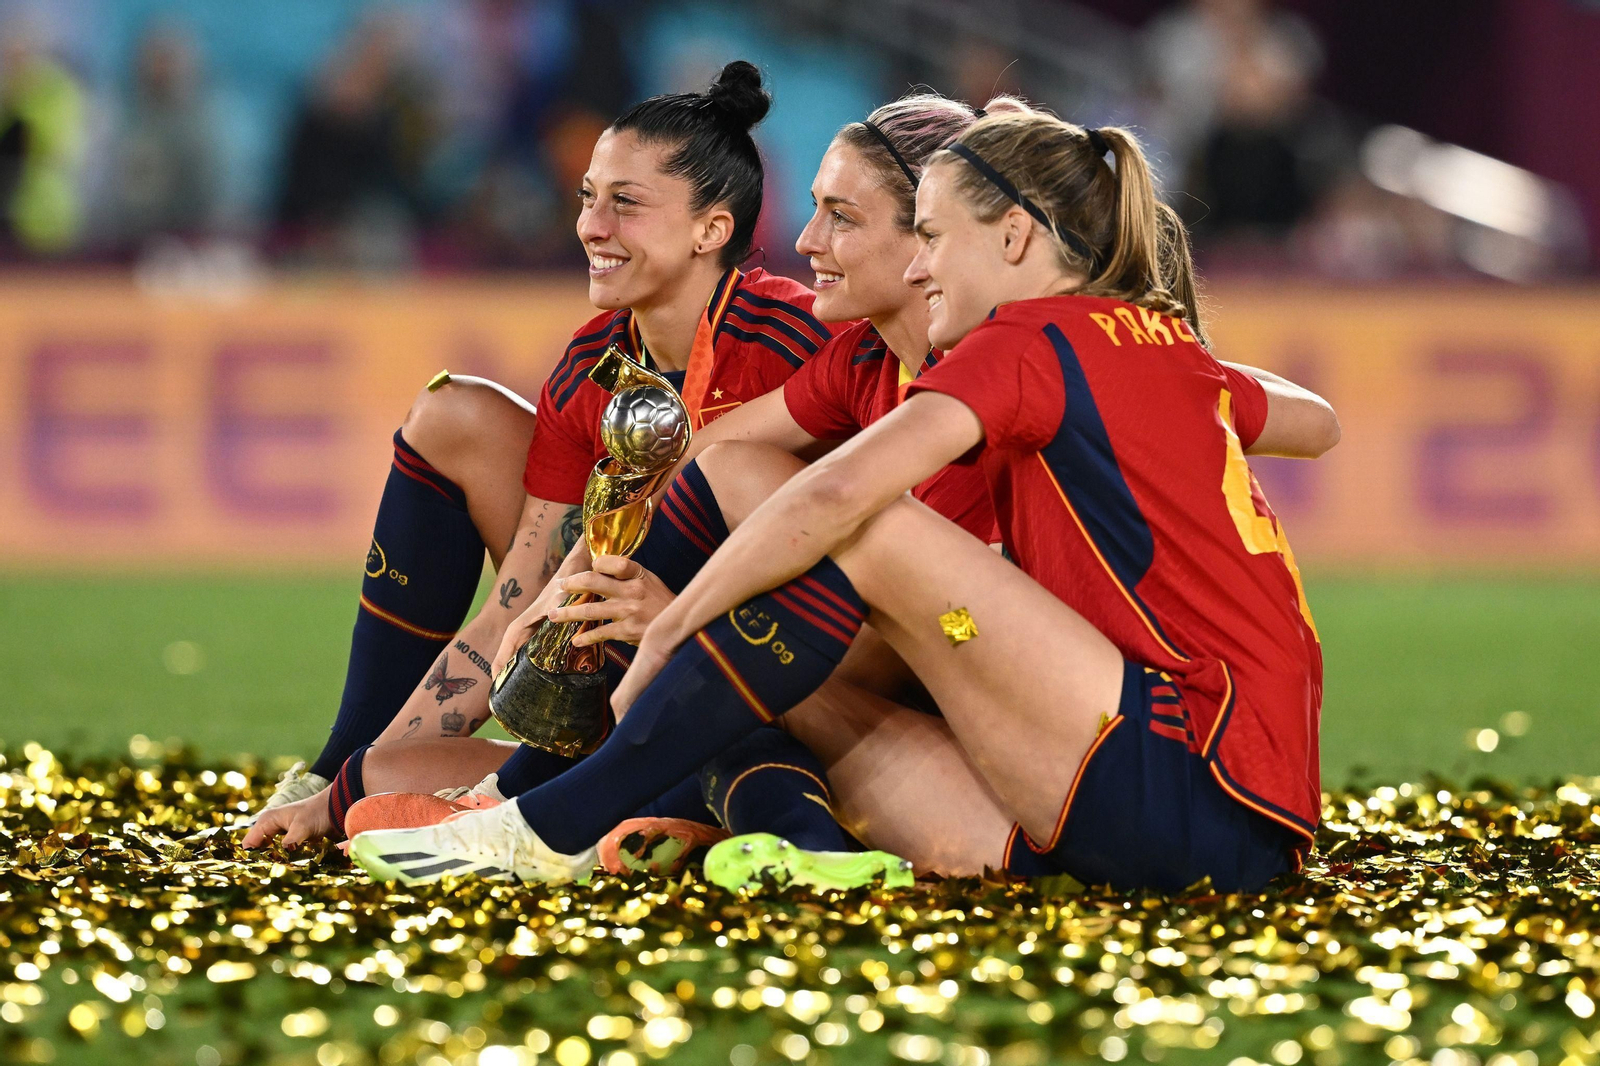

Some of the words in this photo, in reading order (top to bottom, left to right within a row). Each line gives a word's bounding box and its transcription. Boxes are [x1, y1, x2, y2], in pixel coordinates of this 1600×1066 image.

[454, 639, 470, 654] MO
[468, 650, 493, 680] CUISH
[771, 640, 795, 665] 09
